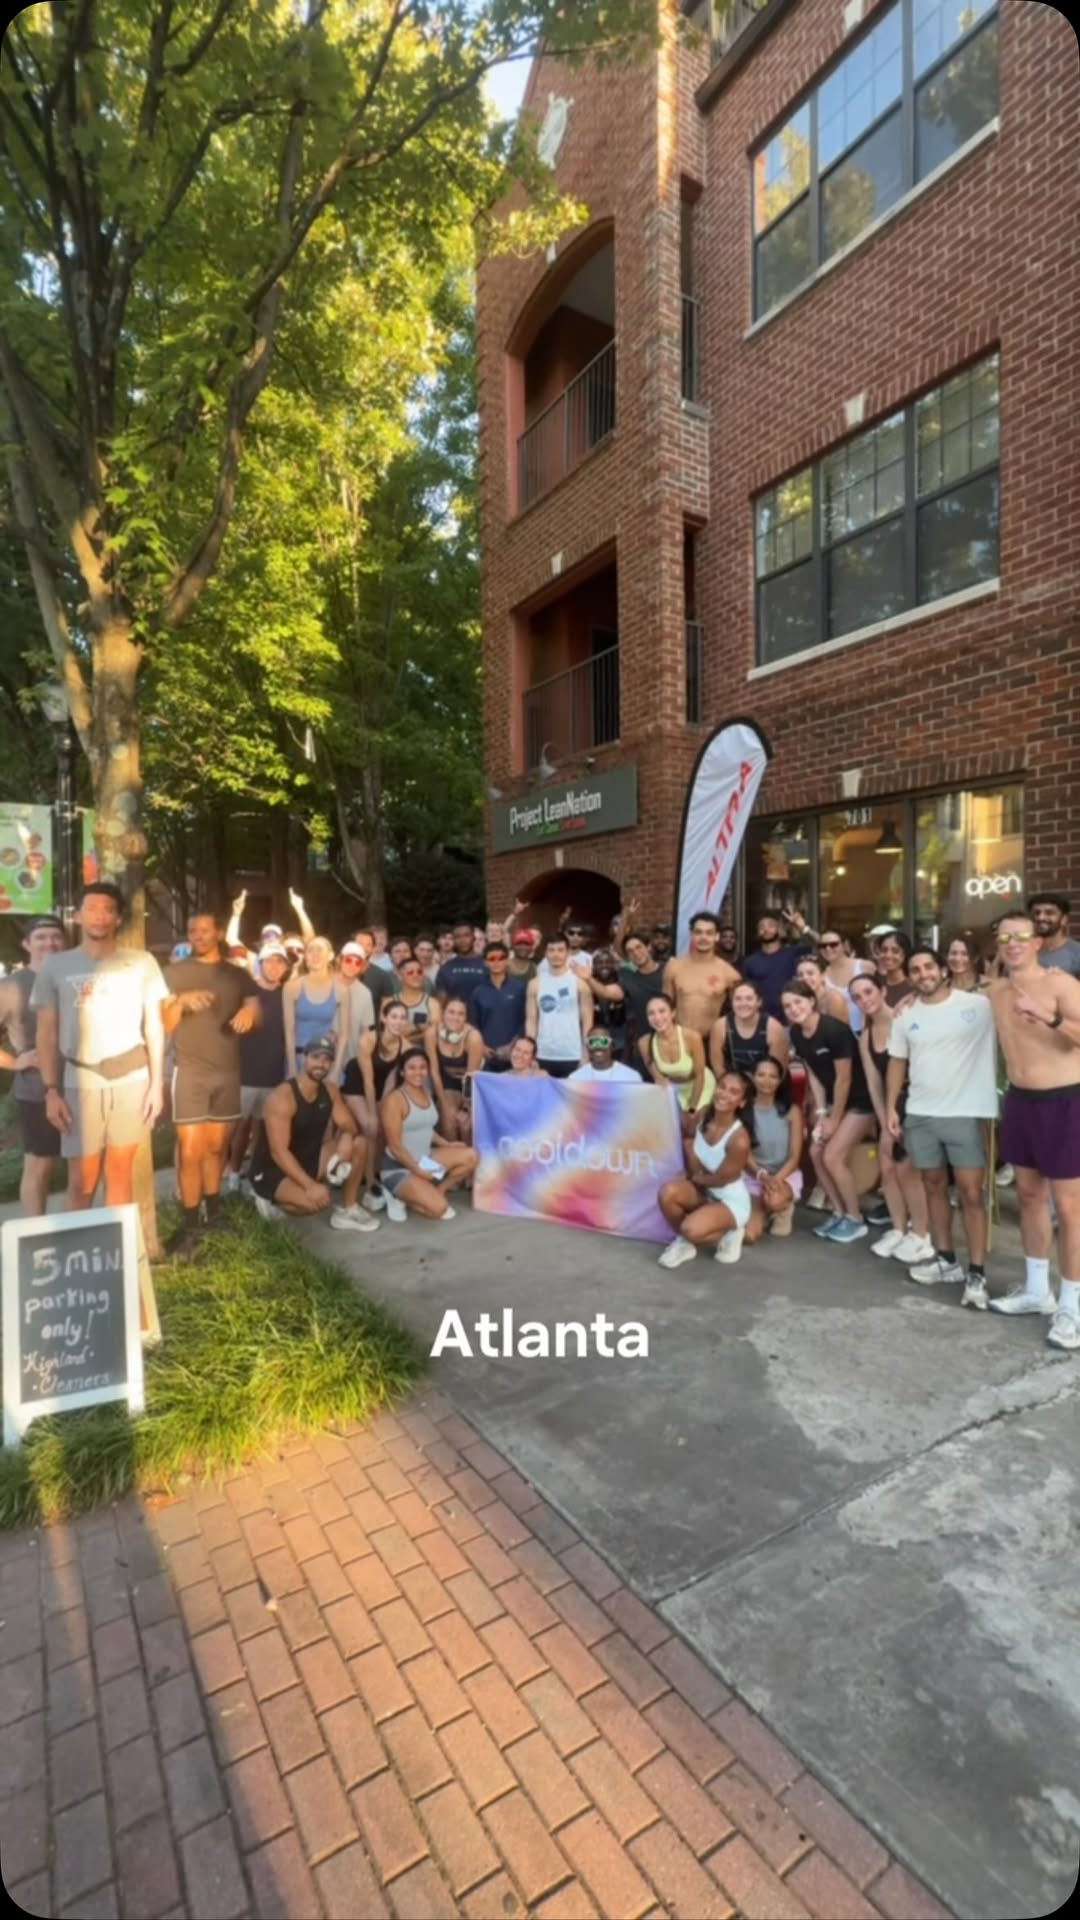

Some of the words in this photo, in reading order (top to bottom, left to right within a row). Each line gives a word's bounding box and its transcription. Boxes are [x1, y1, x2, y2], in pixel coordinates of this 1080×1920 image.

[509, 803, 543, 835] Project
[543, 789, 602, 822] LeanNation
[964, 873, 1022, 899] open
[31, 1247, 62, 1286] 5
[24, 1287, 110, 1325] parking
[40, 1310, 94, 1347] only!
